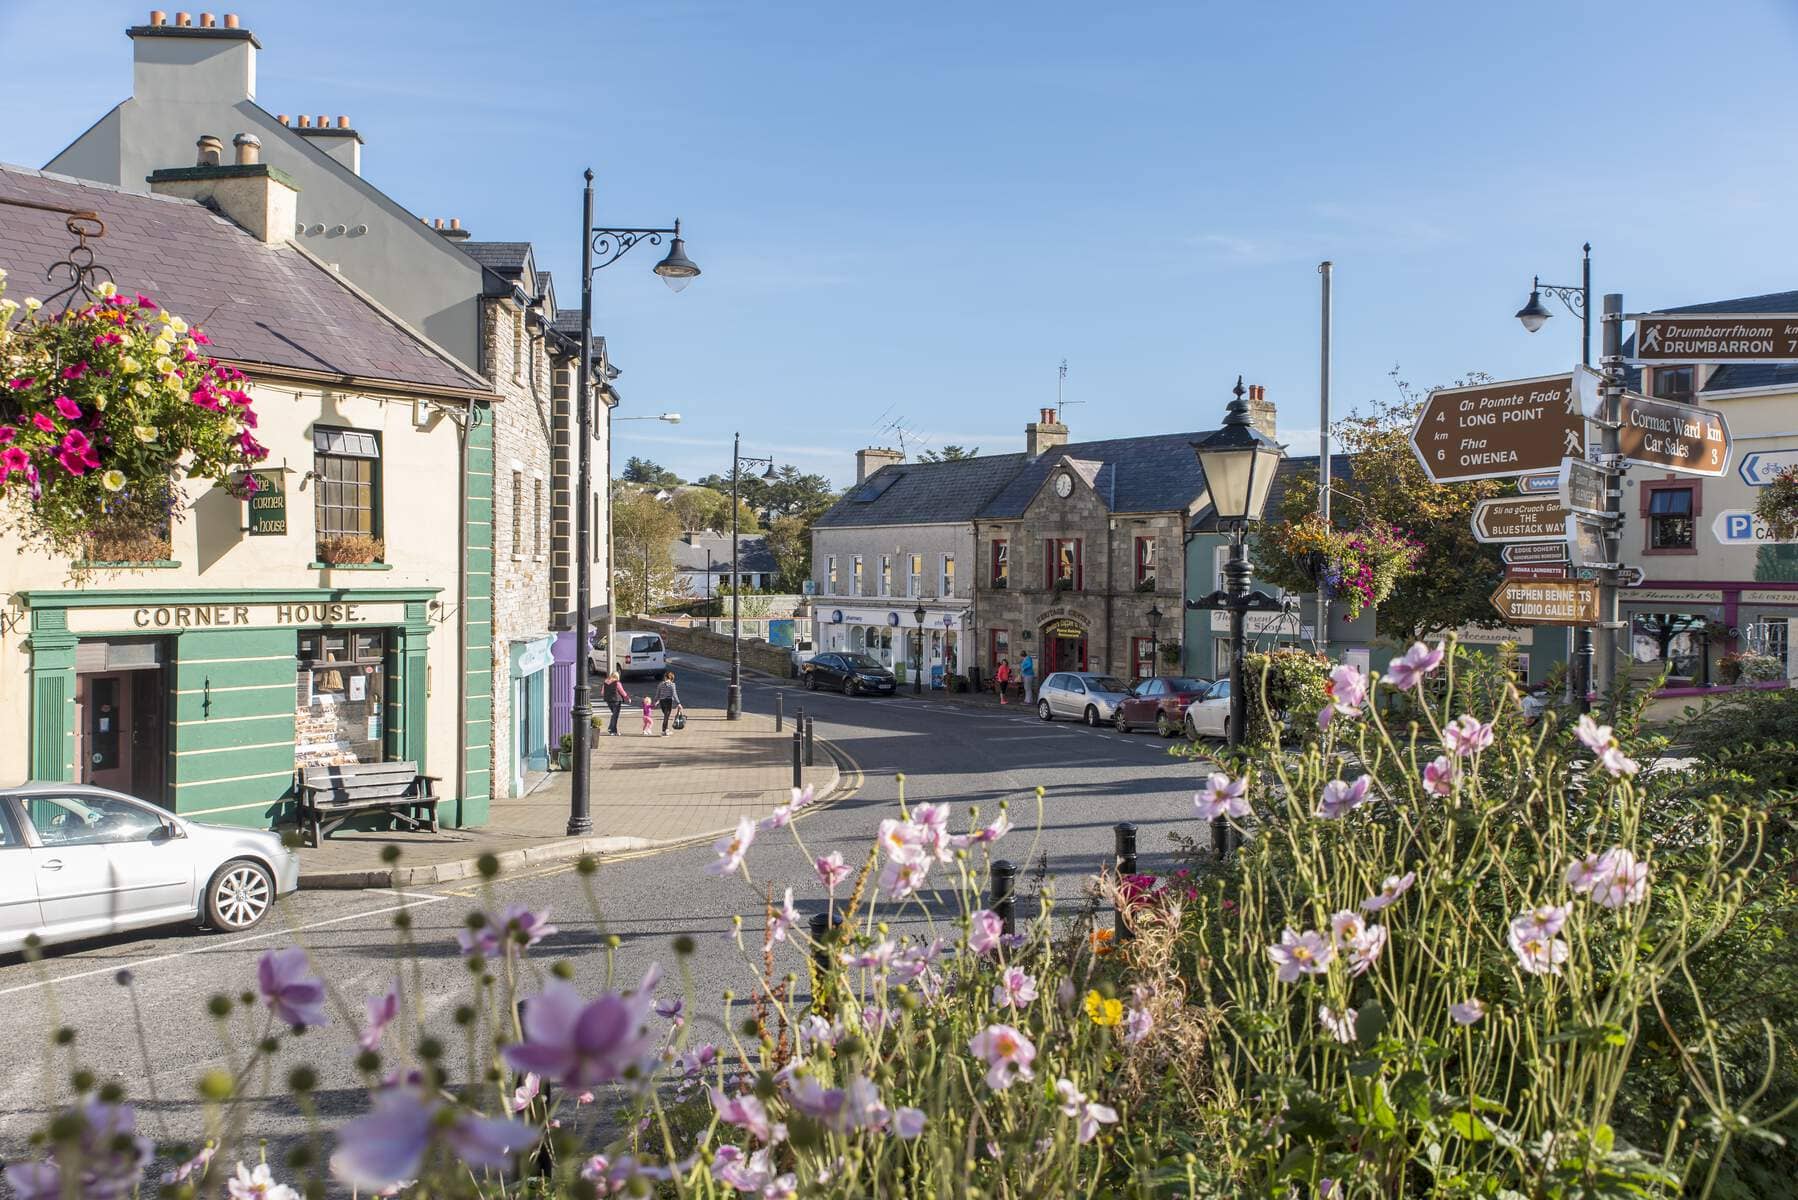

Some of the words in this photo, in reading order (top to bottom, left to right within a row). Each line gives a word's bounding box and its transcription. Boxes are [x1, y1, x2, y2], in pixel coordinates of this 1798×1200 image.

[1664, 340, 1774, 353] DRUMBARRON
[1787, 340, 1797, 353] 7
[1529, 389, 1561, 404] Fada
[1436, 411, 1446, 423] 4
[1459, 413, 1496, 428] LONG
[1502, 408, 1544, 423] POINT
[1631, 408, 1671, 433] Cormac
[1673, 417, 1701, 439] Ward
[1706, 423, 1722, 442] km
[1434, 432, 1449, 441] km
[1644, 434, 1663, 453] Car
[1664, 437, 1689, 458] Sales
[1437, 449, 1446, 461] 6
[1460, 450, 1518, 466] OWENEA
[1711, 448, 1718, 465] 3
[259, 516, 286, 533] house
[1520, 513, 1537, 523] THE
[1492, 524, 1543, 535] BLUESTACK
[1545, 522, 1565, 533] WAY
[1532, 545, 1560, 553] DOHERTY
[1506, 588, 1543, 600] STEPHEN
[1511, 602, 1542, 614] STUDIO
[133, 605, 249, 628] CORNER
[1458, 630, 1522, 642] Accessories
